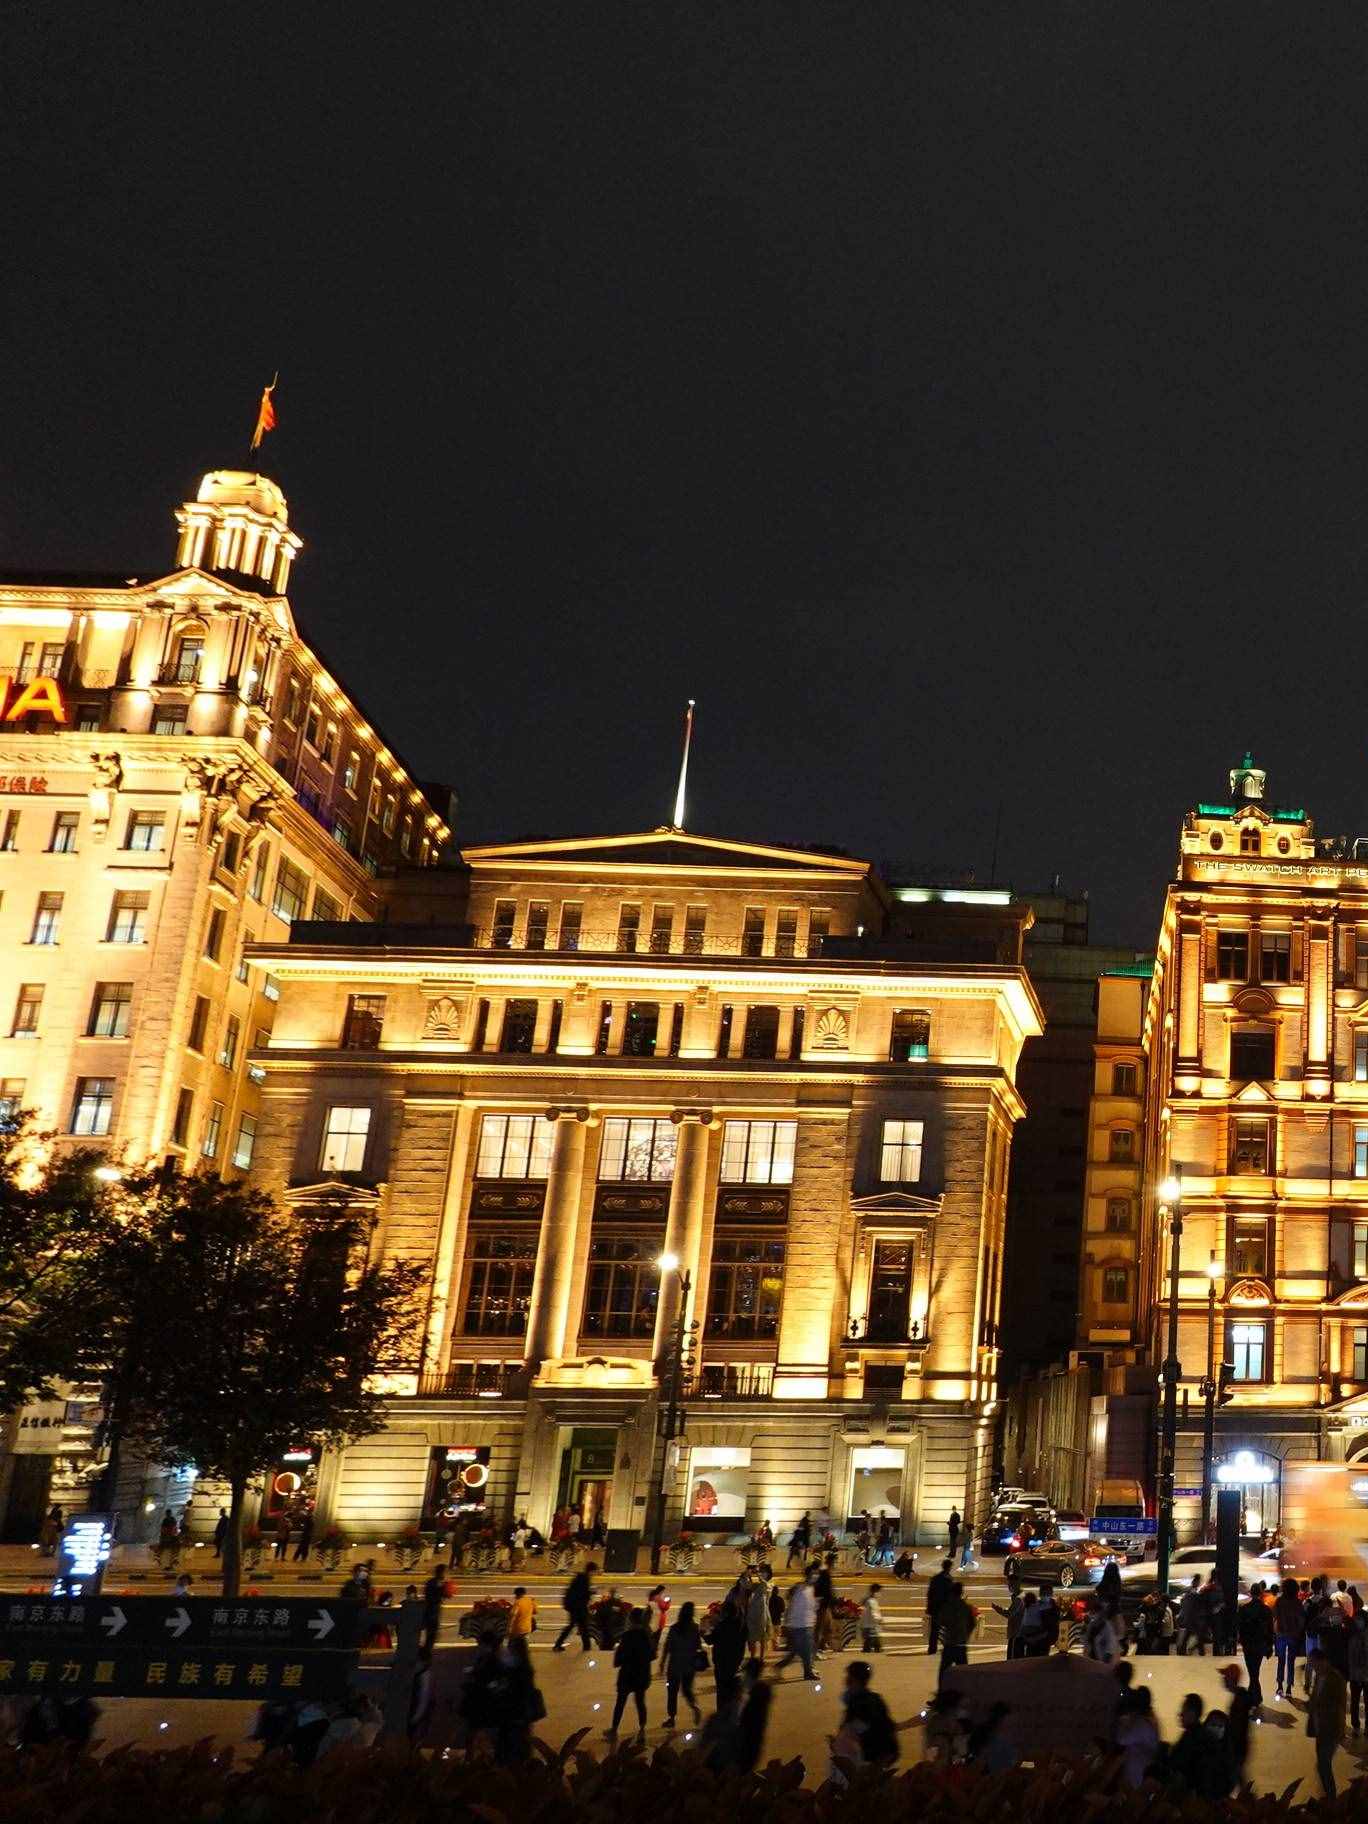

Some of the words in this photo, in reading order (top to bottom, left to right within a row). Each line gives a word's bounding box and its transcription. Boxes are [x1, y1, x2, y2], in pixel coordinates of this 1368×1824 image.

[1194, 861, 1230, 870] THE
[1233, 863, 1302, 875] SWATCH
[1307, 866, 1341, 877] ART
[9, 1605, 85, 1623] 南京东路
[212, 1608, 290, 1626] 南京东路
[146, 1662, 304, 1687] 民族有希望
